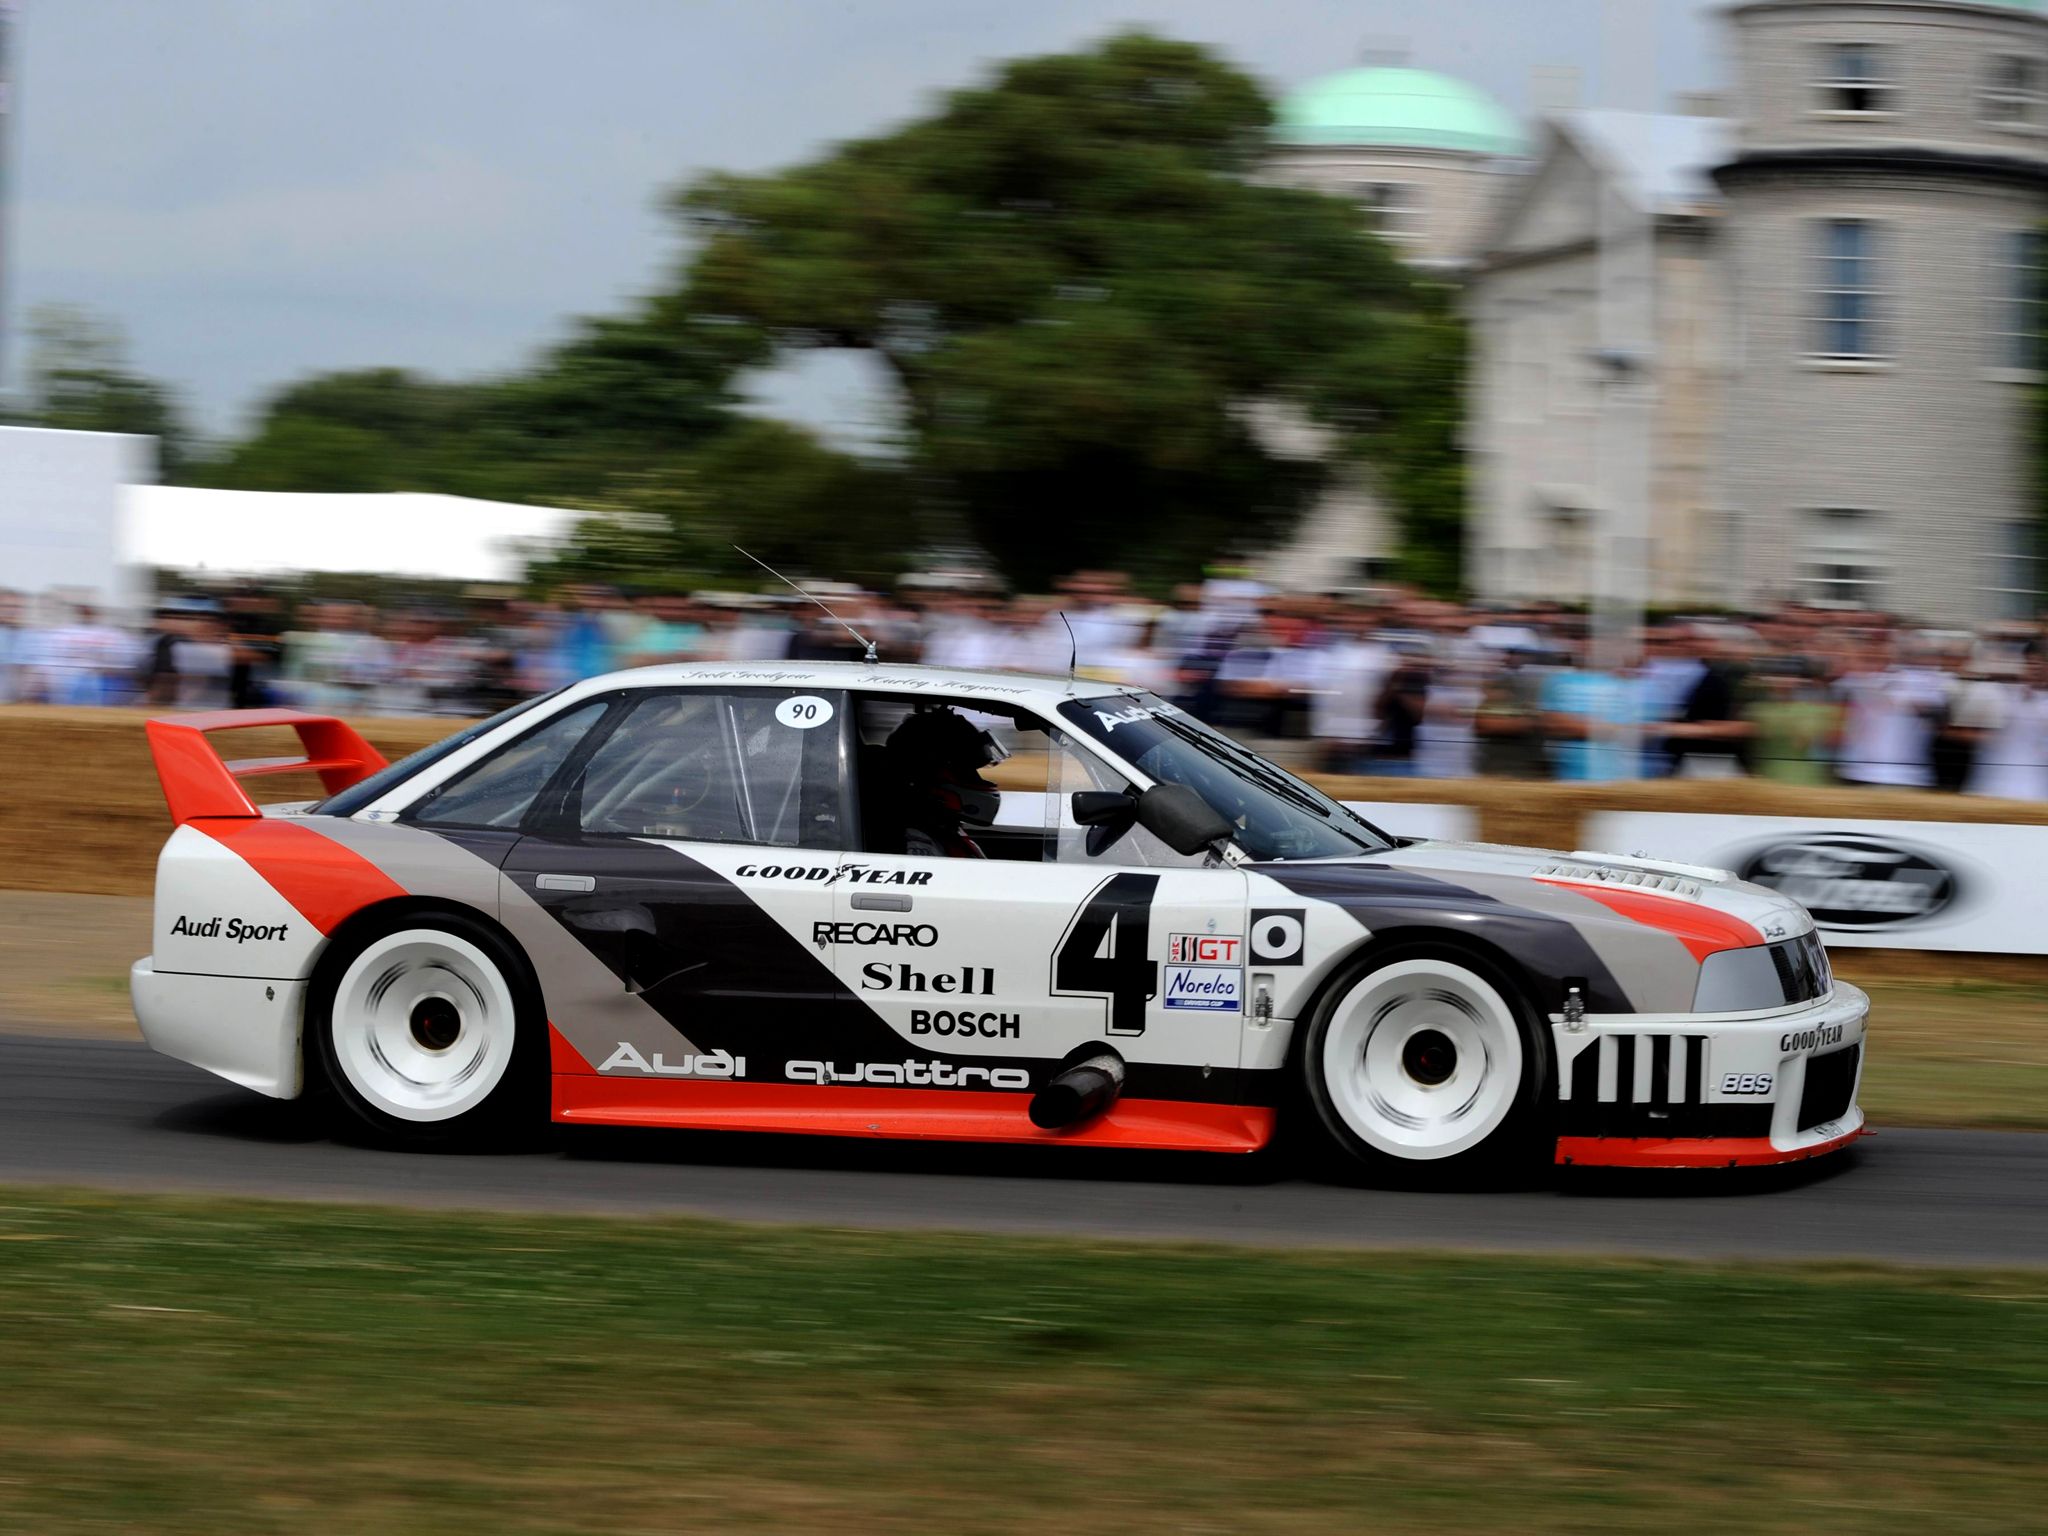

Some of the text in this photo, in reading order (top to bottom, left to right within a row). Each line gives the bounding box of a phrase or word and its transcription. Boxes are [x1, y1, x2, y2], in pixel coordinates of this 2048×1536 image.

[792, 705, 817, 720] 90
[736, 864, 933, 886] GOODYEAR
[170, 915, 288, 944] Audi Sport
[813, 921, 939, 948] RECARO
[1049, 872, 1161, 1038] 4
[1199, 939, 1239, 960] GT
[861, 962, 996, 995] Shell
[1168, 969, 1235, 996] Norelco
[911, 1009, 1020, 1039] BOSCH
[1780, 1022, 1843, 1052] GOODYEAR
[597, 1042, 1030, 1090] Audi quattro
[1721, 1073, 1773, 1094] BBS
